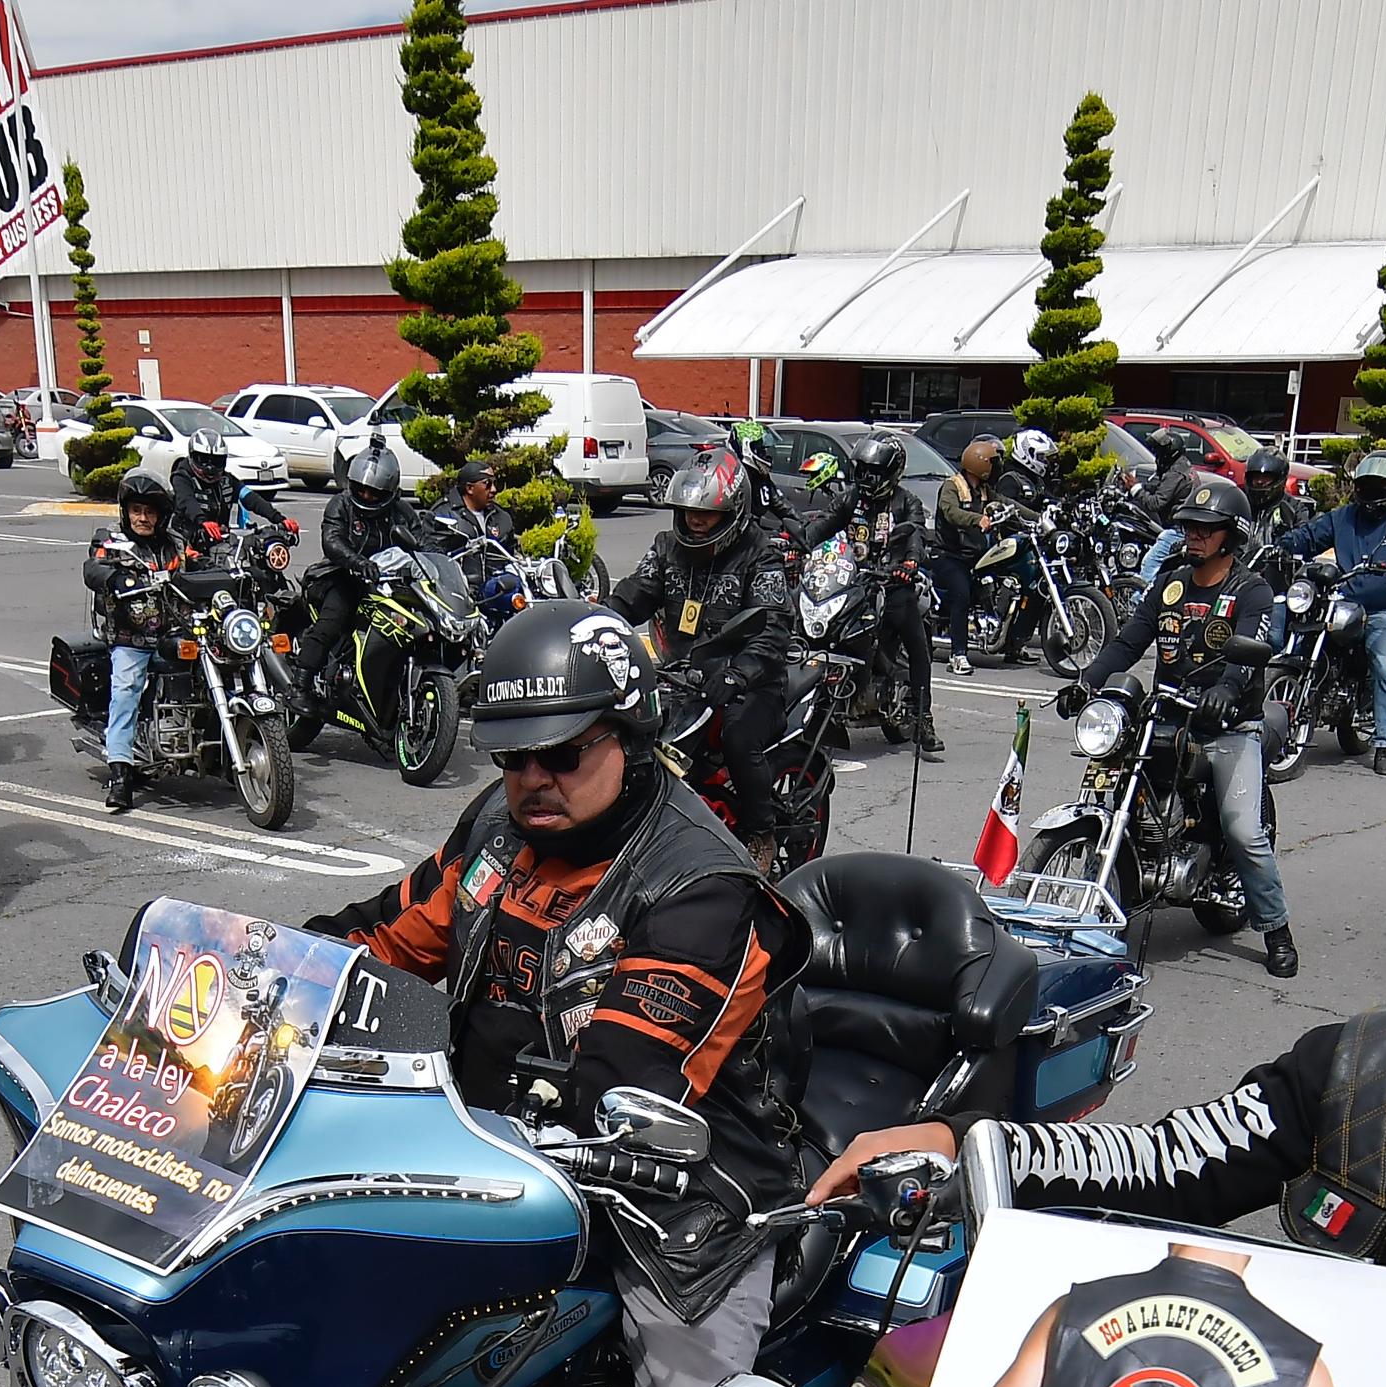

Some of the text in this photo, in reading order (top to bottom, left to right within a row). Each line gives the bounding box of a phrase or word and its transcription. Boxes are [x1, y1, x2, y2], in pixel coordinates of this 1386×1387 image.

[525, 675, 567, 698] L.E.D.T.
[336, 710, 367, 733] HONDA
[572, 924, 611, 946] NACHO
[124, 945, 226, 1046] NO
[99, 1037, 193, 1105] a la ley
[68, 1073, 178, 1138] Chaleco
[43, 1110, 234, 1202] Somos motociclistas, no
[55, 1155, 158, 1216] delincuentes.
[1099, 1303, 1261, 1374] NO A LA LEY CHALECO
